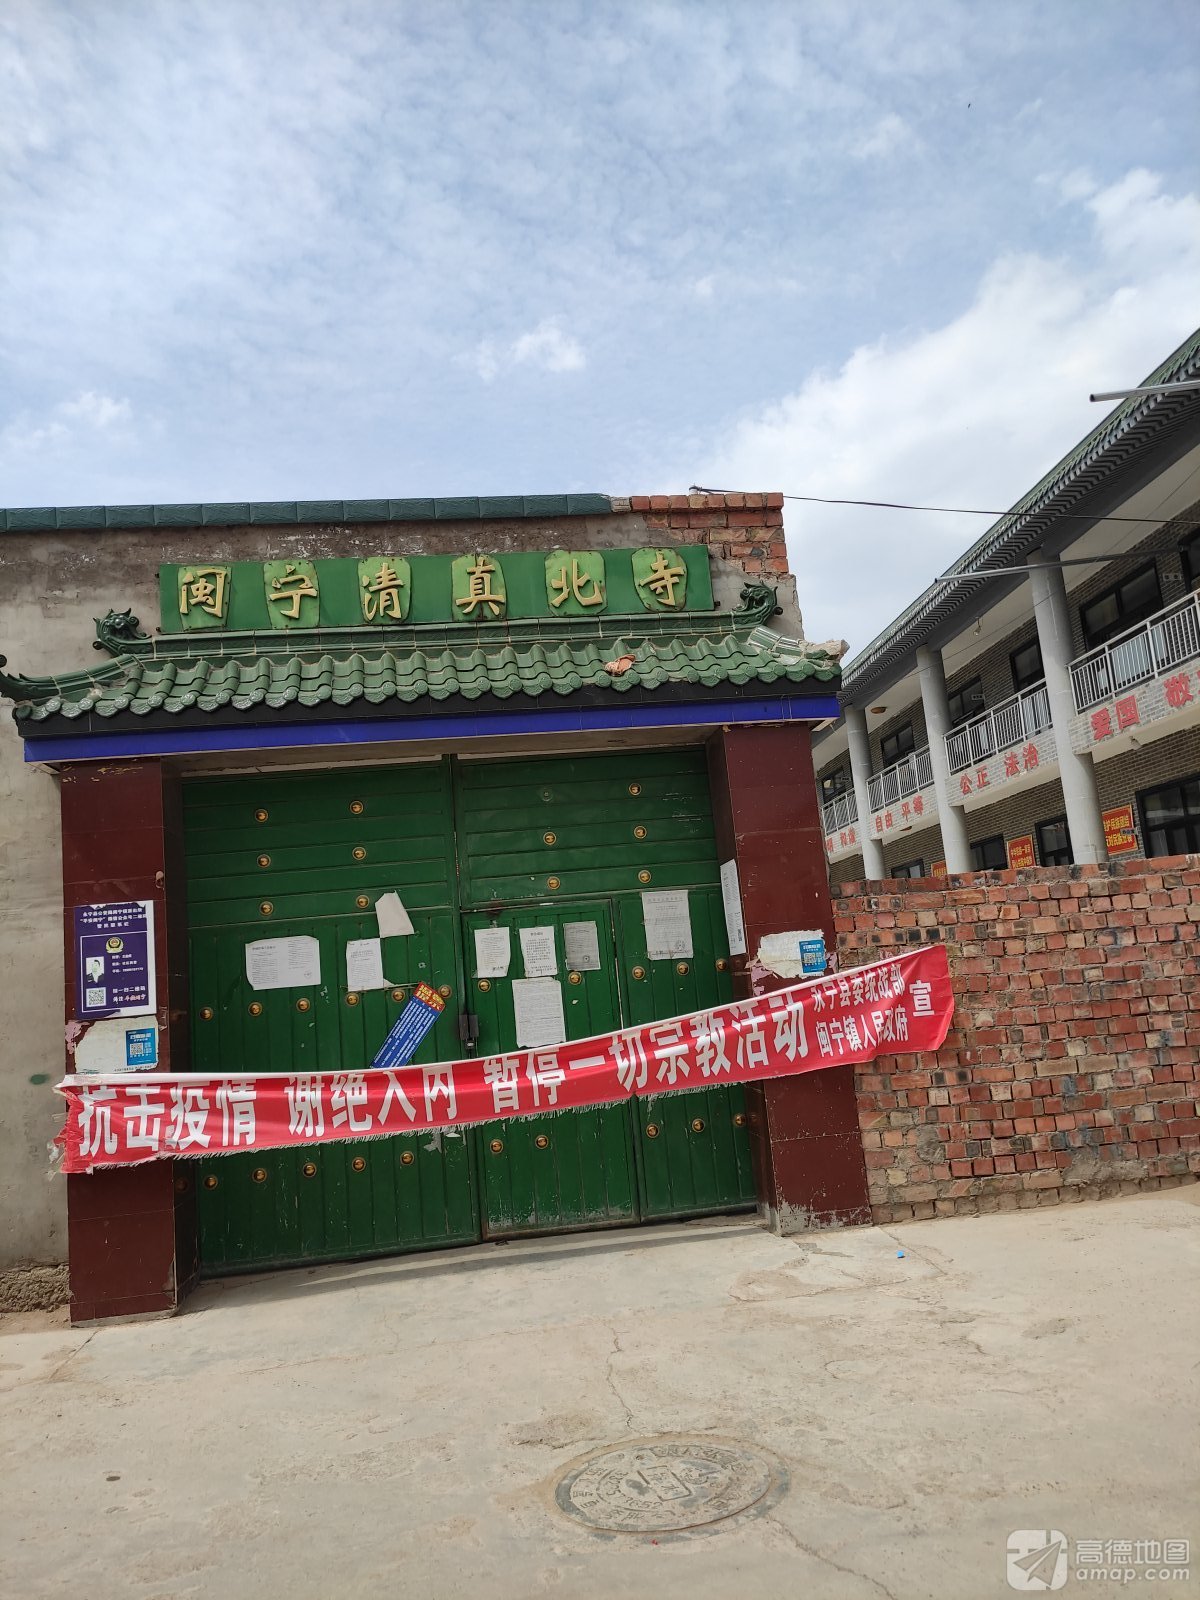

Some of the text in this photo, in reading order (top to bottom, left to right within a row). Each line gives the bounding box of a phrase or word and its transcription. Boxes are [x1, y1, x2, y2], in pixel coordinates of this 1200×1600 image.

[180, 556, 684, 619] 闽宁清真北寺
[1091, 670, 1200, 741] 爱国 敬
[960, 742, 1039, 795] 公正 法治
[875, 794, 923, 833] 自由 平等
[811, 963, 905, 1012] 永宁县委统战部
[909, 980, 935, 1017] 宣
[816, 1004, 909, 1057] 闽宁镇人民政府
[78, 1079, 257, 1156] 抗击疫情
[284, 1068, 457, 1137] 谢绝入内
[483, 992, 809, 1113] 暂停一切宗教活动
